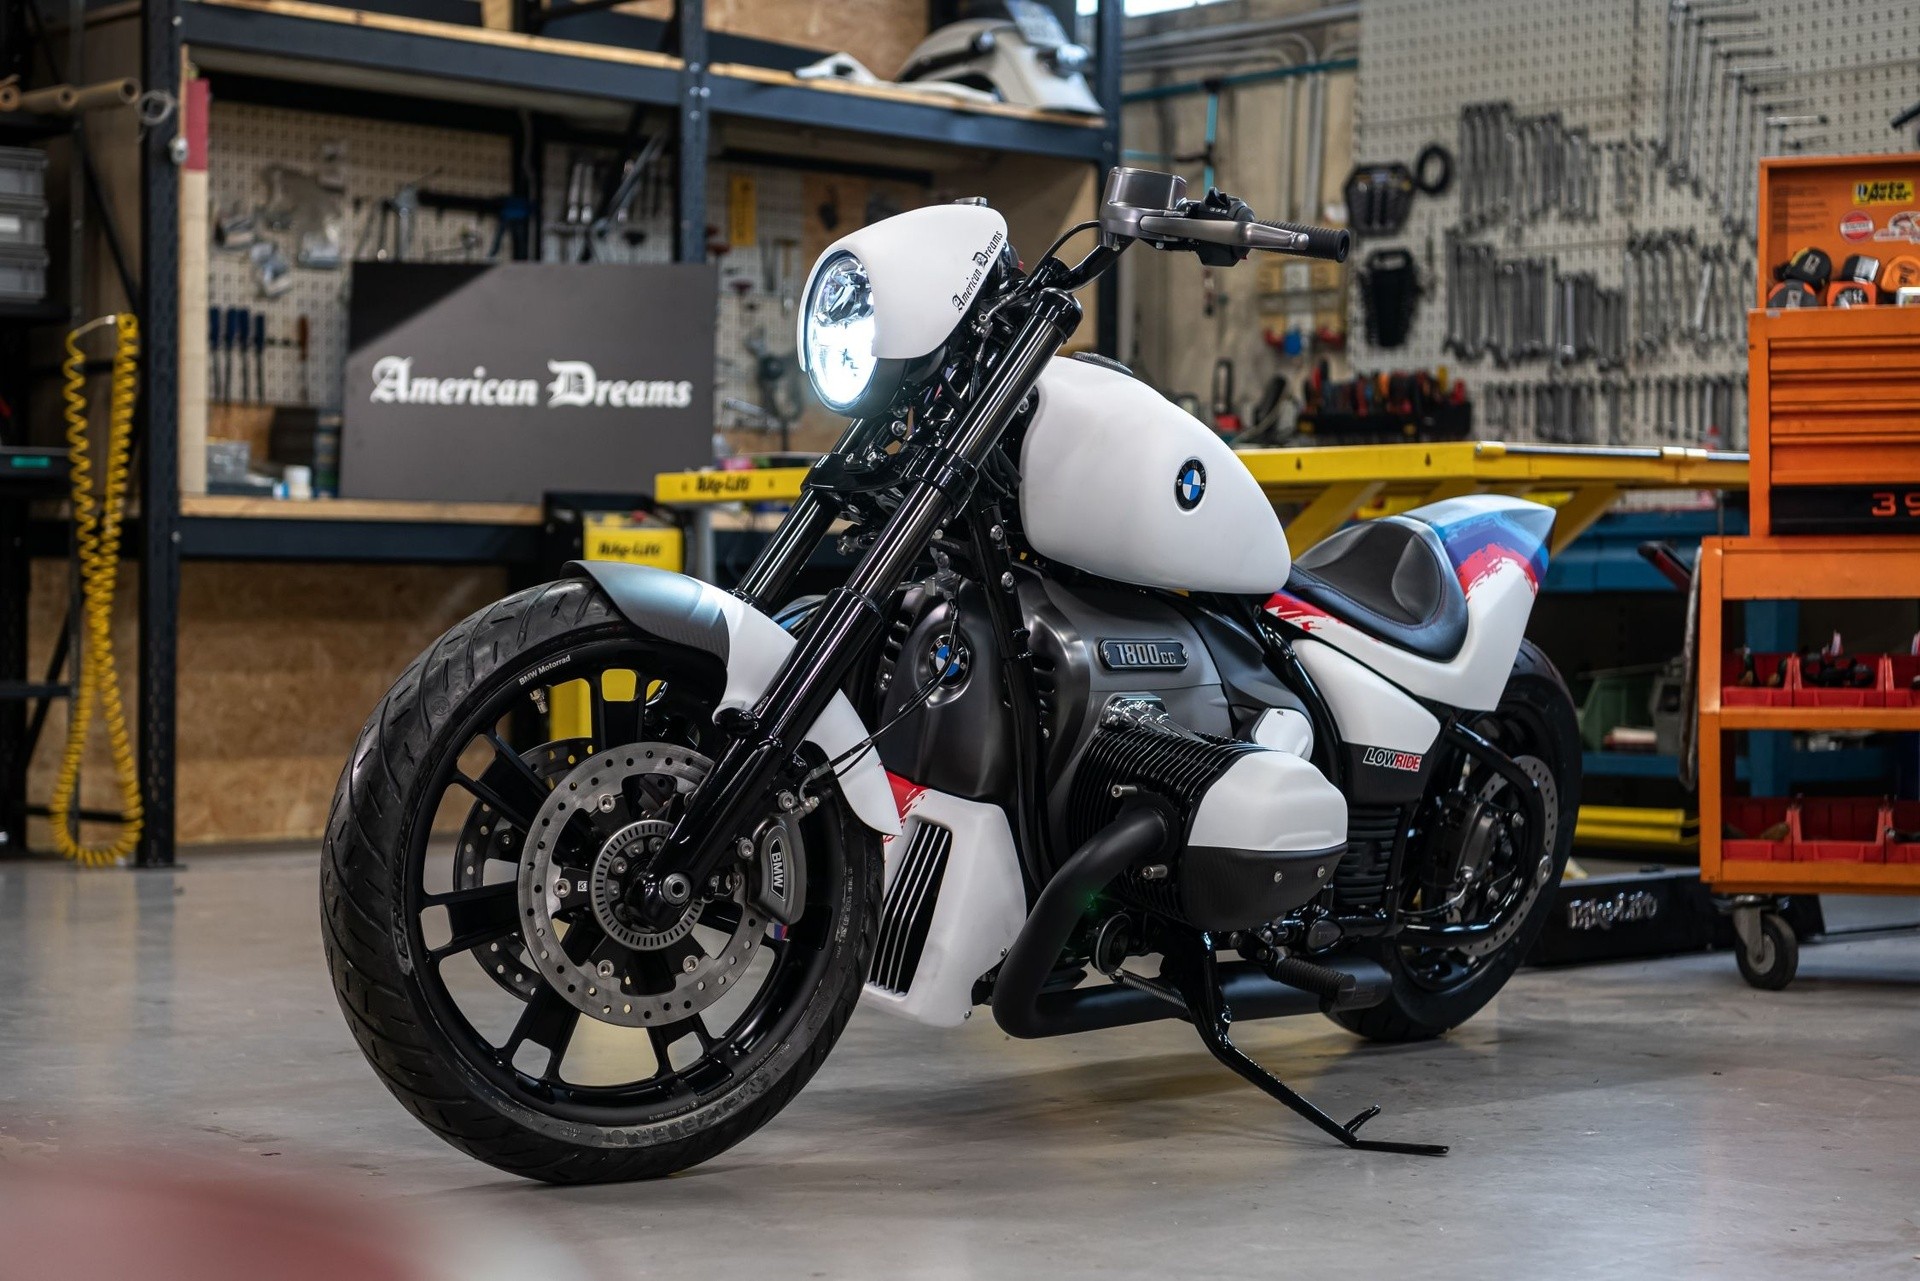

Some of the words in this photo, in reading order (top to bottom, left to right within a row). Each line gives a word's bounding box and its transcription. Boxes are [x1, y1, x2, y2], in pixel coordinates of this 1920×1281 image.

[951, 268, 983, 313] American
[971, 230, 1003, 268] Dreams
[370, 356, 538, 407] American
[547, 359, 693, 408] Dreams
[518, 669, 538, 685] BMW
[537, 654, 571, 674] Motorrad
[1363, 747, 1422, 772] LOWRIDE
[771, 851, 784, 888] BMW
